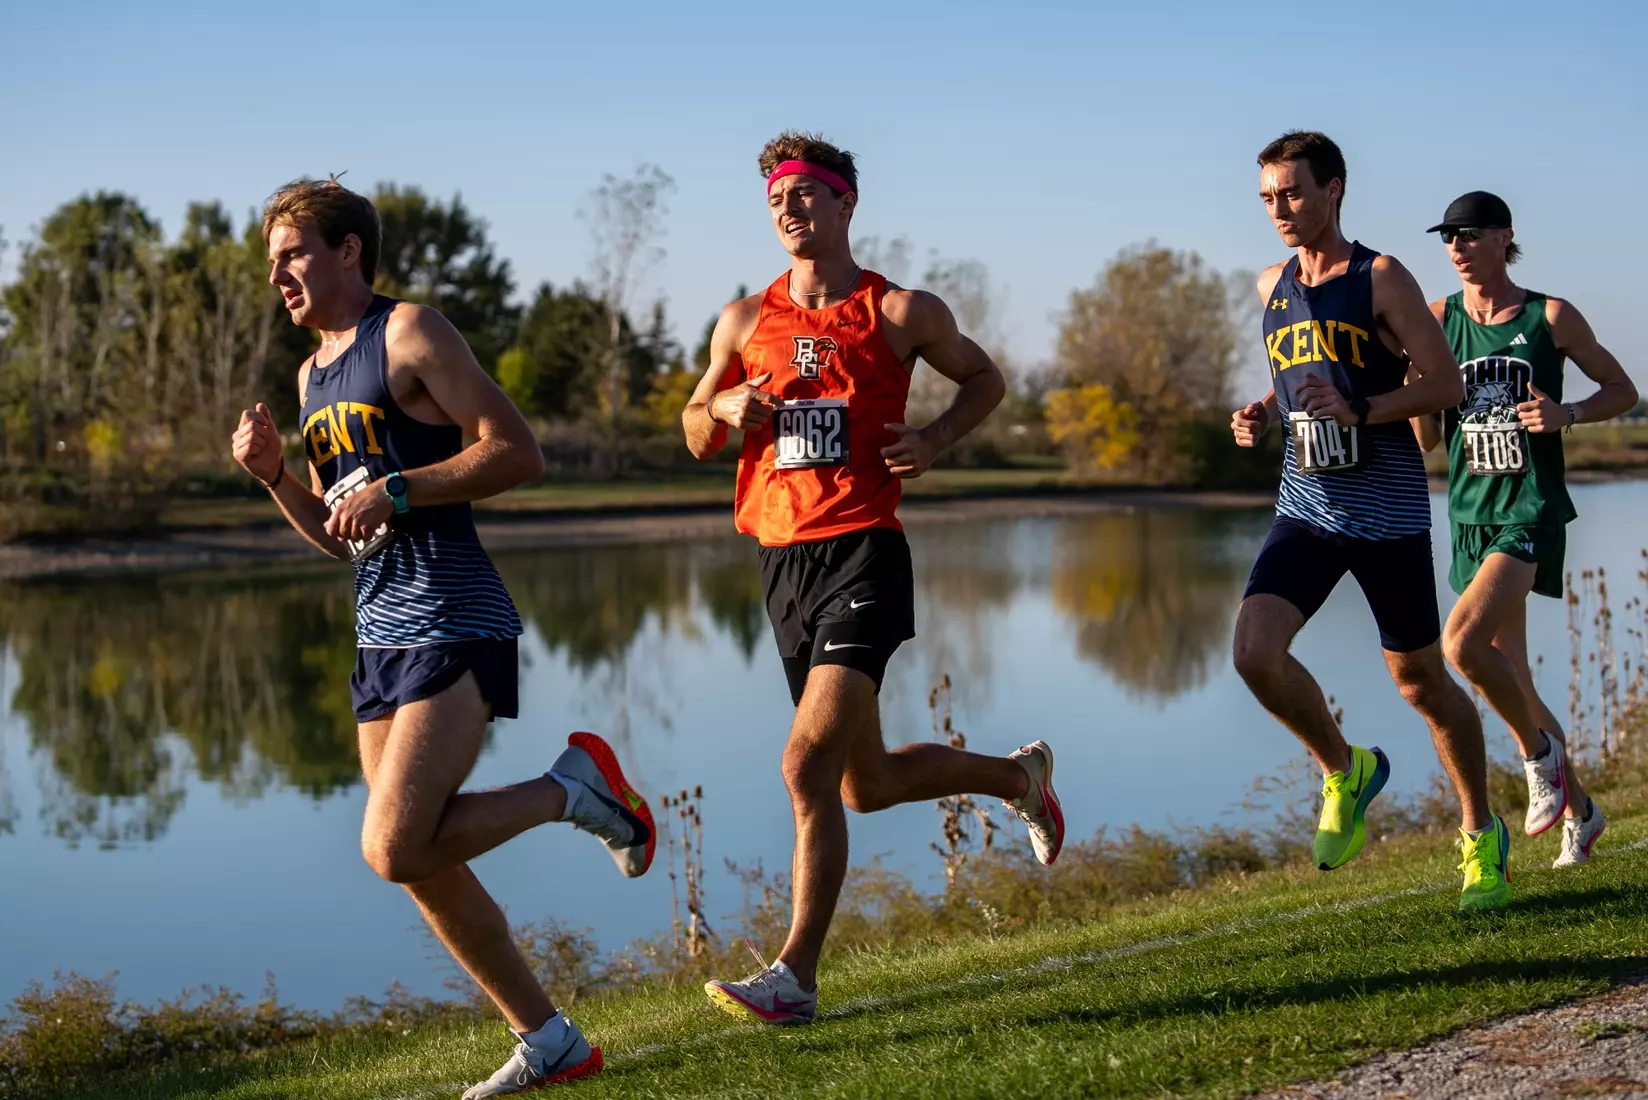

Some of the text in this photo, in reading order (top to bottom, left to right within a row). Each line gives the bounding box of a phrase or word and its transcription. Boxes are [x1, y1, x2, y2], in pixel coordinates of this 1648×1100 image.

[1266, 320, 1369, 378] KENT
[303, 402, 385, 467] ENT
[1296, 421, 1359, 468] 7047
[1466, 430, 1523, 470] 7108
